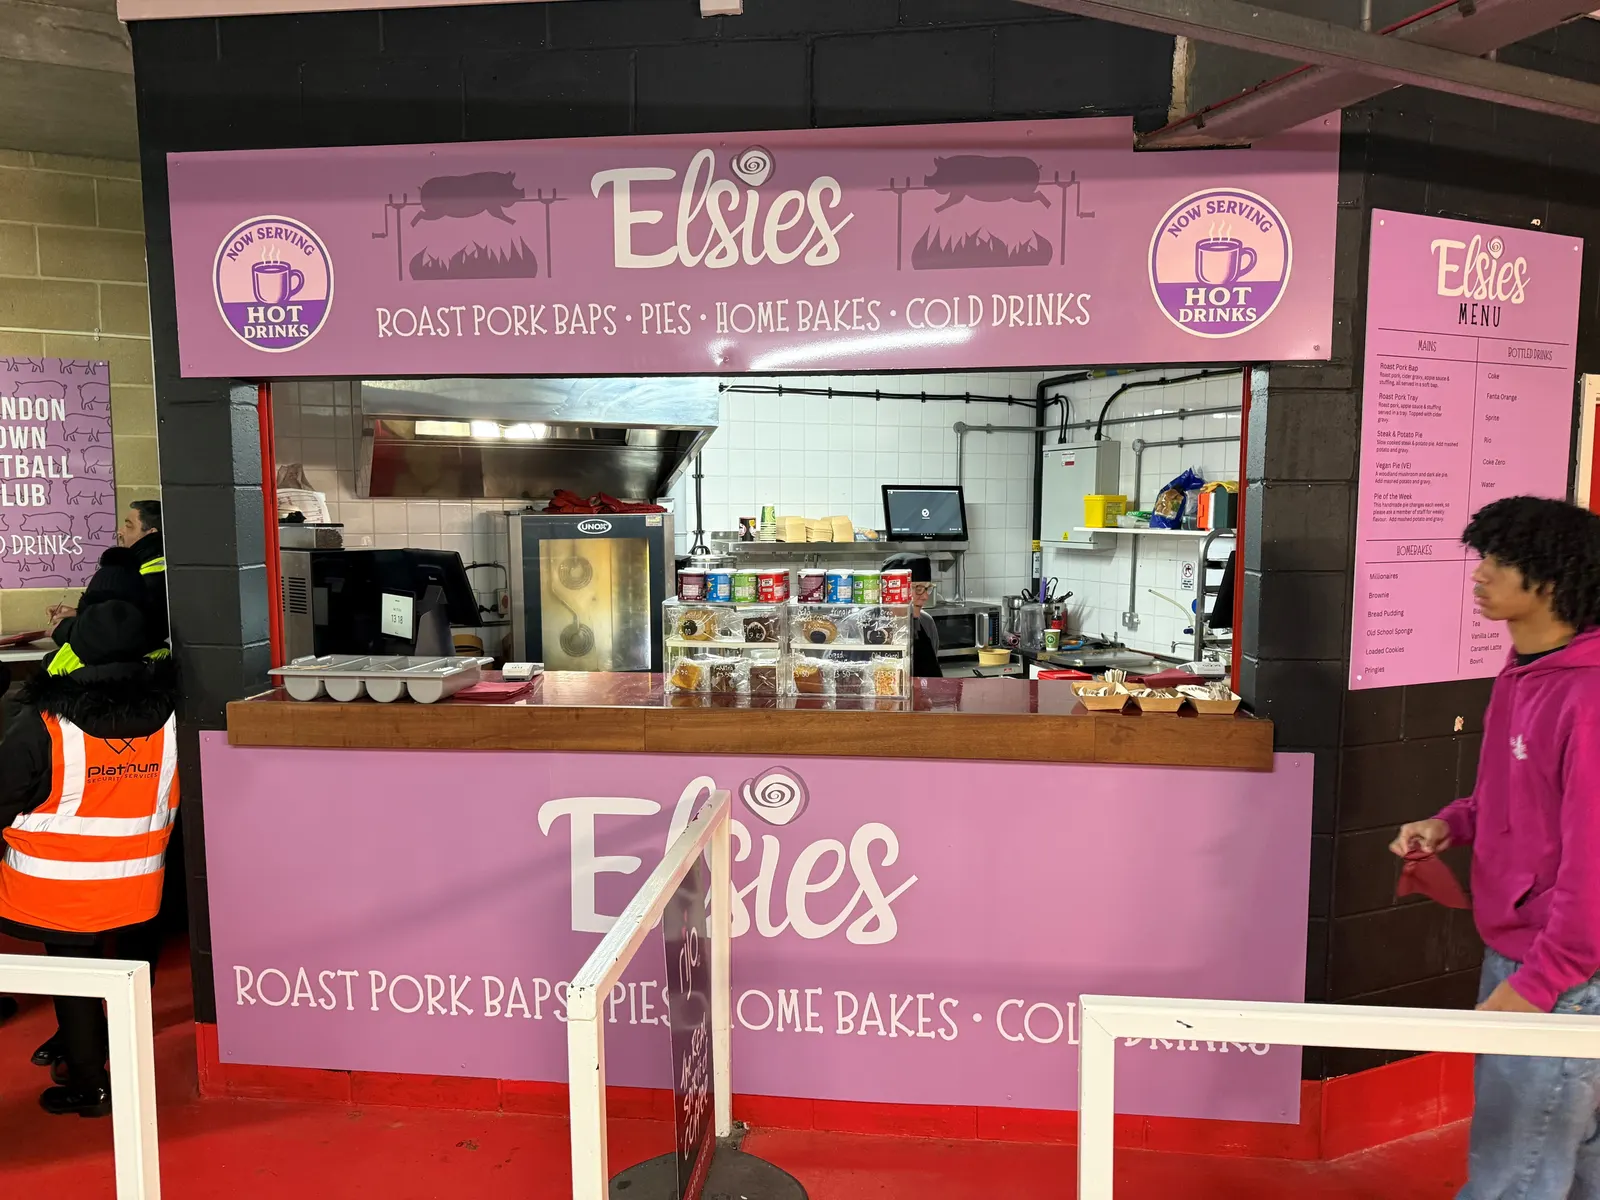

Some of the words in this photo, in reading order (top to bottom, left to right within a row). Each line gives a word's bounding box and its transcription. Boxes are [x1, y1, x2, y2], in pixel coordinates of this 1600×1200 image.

[590, 147, 854, 269] Elsies
[1168, 205, 1201, 238] NOW
[1206, 200, 1273, 233] SERVING
[226, 232, 254, 261] NOW
[257, 227, 315, 256] SERVING
[1431, 234, 1531, 304] Elsies
[1185, 287, 1252, 306] HOT
[247, 305, 303, 323] HOT
[376, 305, 466, 337] ROAST
[472, 304, 547, 336] PORK
[553, 303, 617, 336] BAPS
[640, 301, 692, 335] PIES
[715, 299, 789, 333] HOME
[796, 297, 882, 332] BAKES
[905, 295, 984, 330] COLD
[991, 293, 1092, 328] DRINKS
[1179, 307, 1257, 323] DRINKS
[1458, 303, 1501, 327] MENU
[244, 324, 309, 339] DRINKS
[1418, 340, 1437, 352] MAINS
[1533, 348, 1553, 361] DRINKS
[1395, 363, 1407, 371] Pork
[1408, 364, 1419, 372] Bap
[1487, 372, 1500, 380] Coke
[1394, 393, 1406, 401] Pork
[1407, 394, 1419, 403] Tray
[1486, 392, 1500, 400] Fanta
[1500, 393, 1517, 402] Orange
[1485, 414, 1500, 422] Sprite
[1377, 430, 1391, 438] Steak
[1483, 436, 1492, 444] Rio
[1375, 462, 1391, 470] Vegan
[581, 523, 608, 531] UNOX
[11, 534, 83, 556] DRINKS
[1368, 610, 1383, 618] Bread
[1383, 609, 1404, 617] Pudding
[1366, 629, 1376, 637] Old
[1376, 628, 1394, 636] School
[1394, 628, 1413, 636] Sponge
[1471, 632, 1487, 640] Vanilla
[1385, 646, 1405, 654] Cookies
[1469, 657, 1484, 665] Bovril
[1364, 666, 1385, 674] Pringles
[87, 776, 120, 784] SECURIT
[233, 965, 359, 1011] ROAST
[368, 970, 474, 1017] PORK
[732, 987, 823, 1034] OME
[834, 990, 960, 1041] BAKES
[996, 998, 1080, 1045] COL
